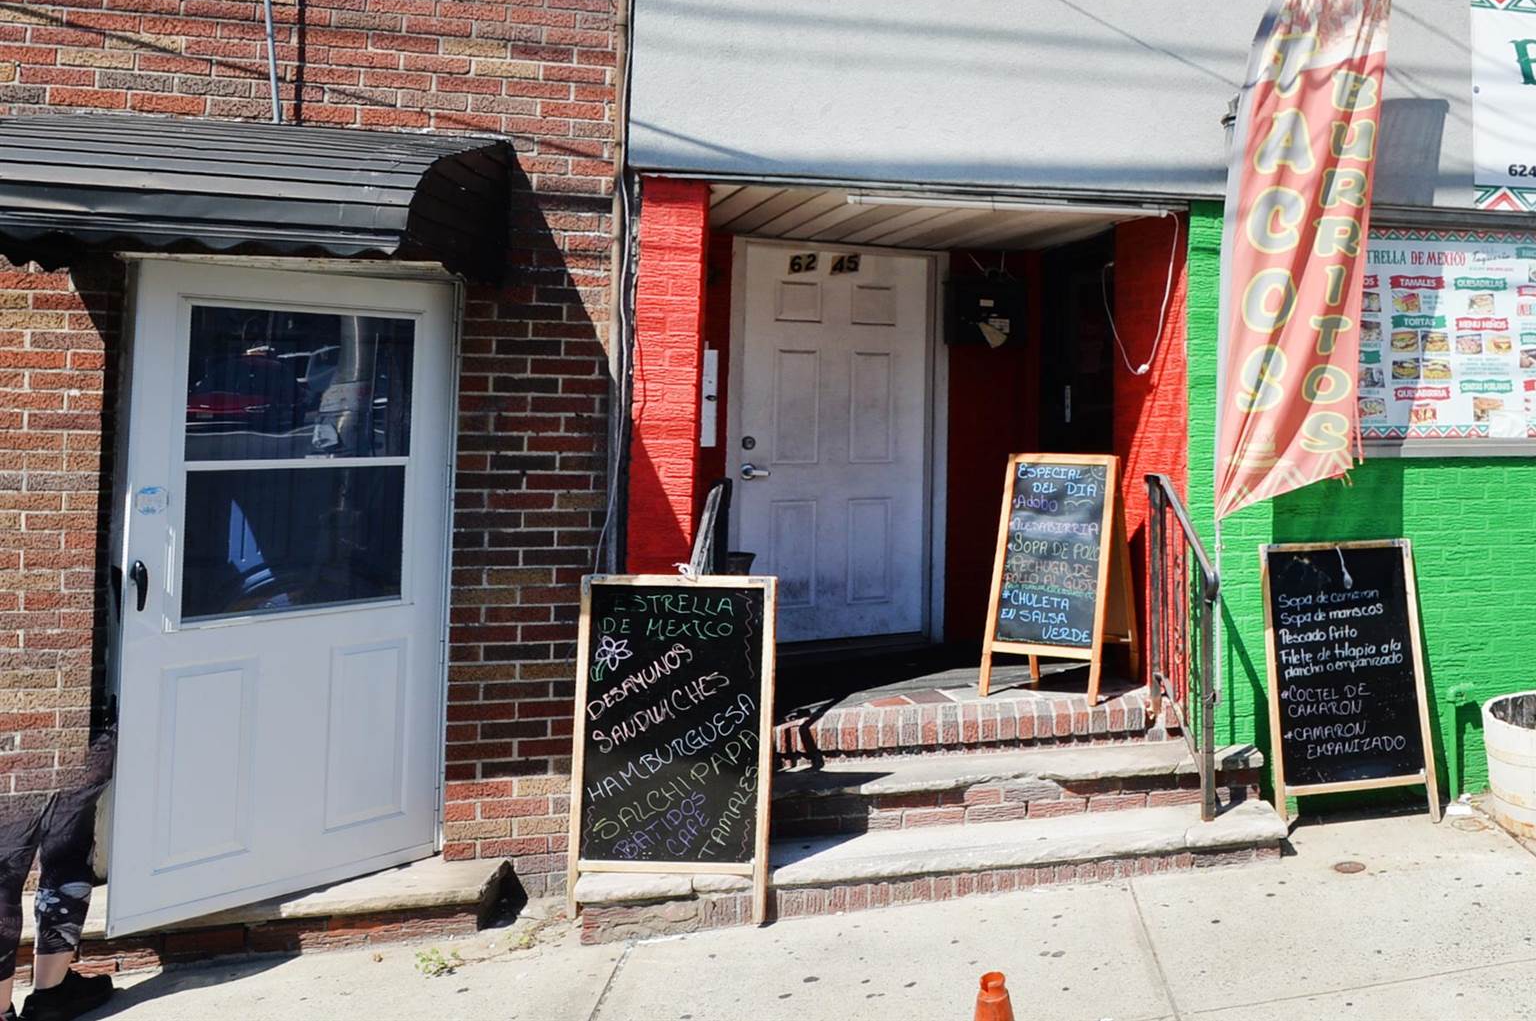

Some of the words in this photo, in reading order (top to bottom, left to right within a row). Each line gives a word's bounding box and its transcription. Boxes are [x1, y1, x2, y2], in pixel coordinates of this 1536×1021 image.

[1237, 32, 1322, 414] TACOS
[1300, 69, 1379, 455] BURRITOS
[1366, 250, 1406, 265] TRELLA
[1411, 251, 1424, 265] DE
[1426, 251, 1467, 266] MEXICO
[1399, 278, 1436, 286] TAMALES
[1404, 318, 1436, 326] TORTAS
[1018, 463, 1082, 479] ESPECIAL
[1032, 482, 1057, 493] DEL
[1065, 482, 1096, 497] DIA
[1052, 542, 1068, 559] DE
[614, 594, 734, 617] ESTRELLA
[1278, 594, 1312, 611] Sopa
[1316, 590, 1328, 603] de
[1019, 610, 1067, 623] SALSA
[1281, 612, 1312, 628] Sopa
[1314, 608, 1327, 621] de
[1329, 603, 1383, 619] mariscos
[603, 617, 631, 633] DE
[646, 618, 733, 640] MEXICO
[1042, 625, 1091, 643] VERDE
[1279, 628, 1327, 645] Pescado
[1328, 624, 1358, 640] frito
[1317, 646, 1331, 660] de
[1334, 641, 1376, 659] tilapia
[586, 643, 693, 721] DESAYUNOS
[1344, 682, 1371, 698] DE
[1288, 700, 1362, 718] CAMARON
[1293, 720, 1366, 741] CAMARON
[587, 693, 756, 802] HAMBURGUESA
[1306, 735, 1406, 760] EMPANIZADO
[592, 729, 759, 840] SALCHIPAPA
[698, 764, 759, 859] TAMALES
[612, 791, 706, 859] BATIDOS
[666, 809, 710, 856] CAFE
